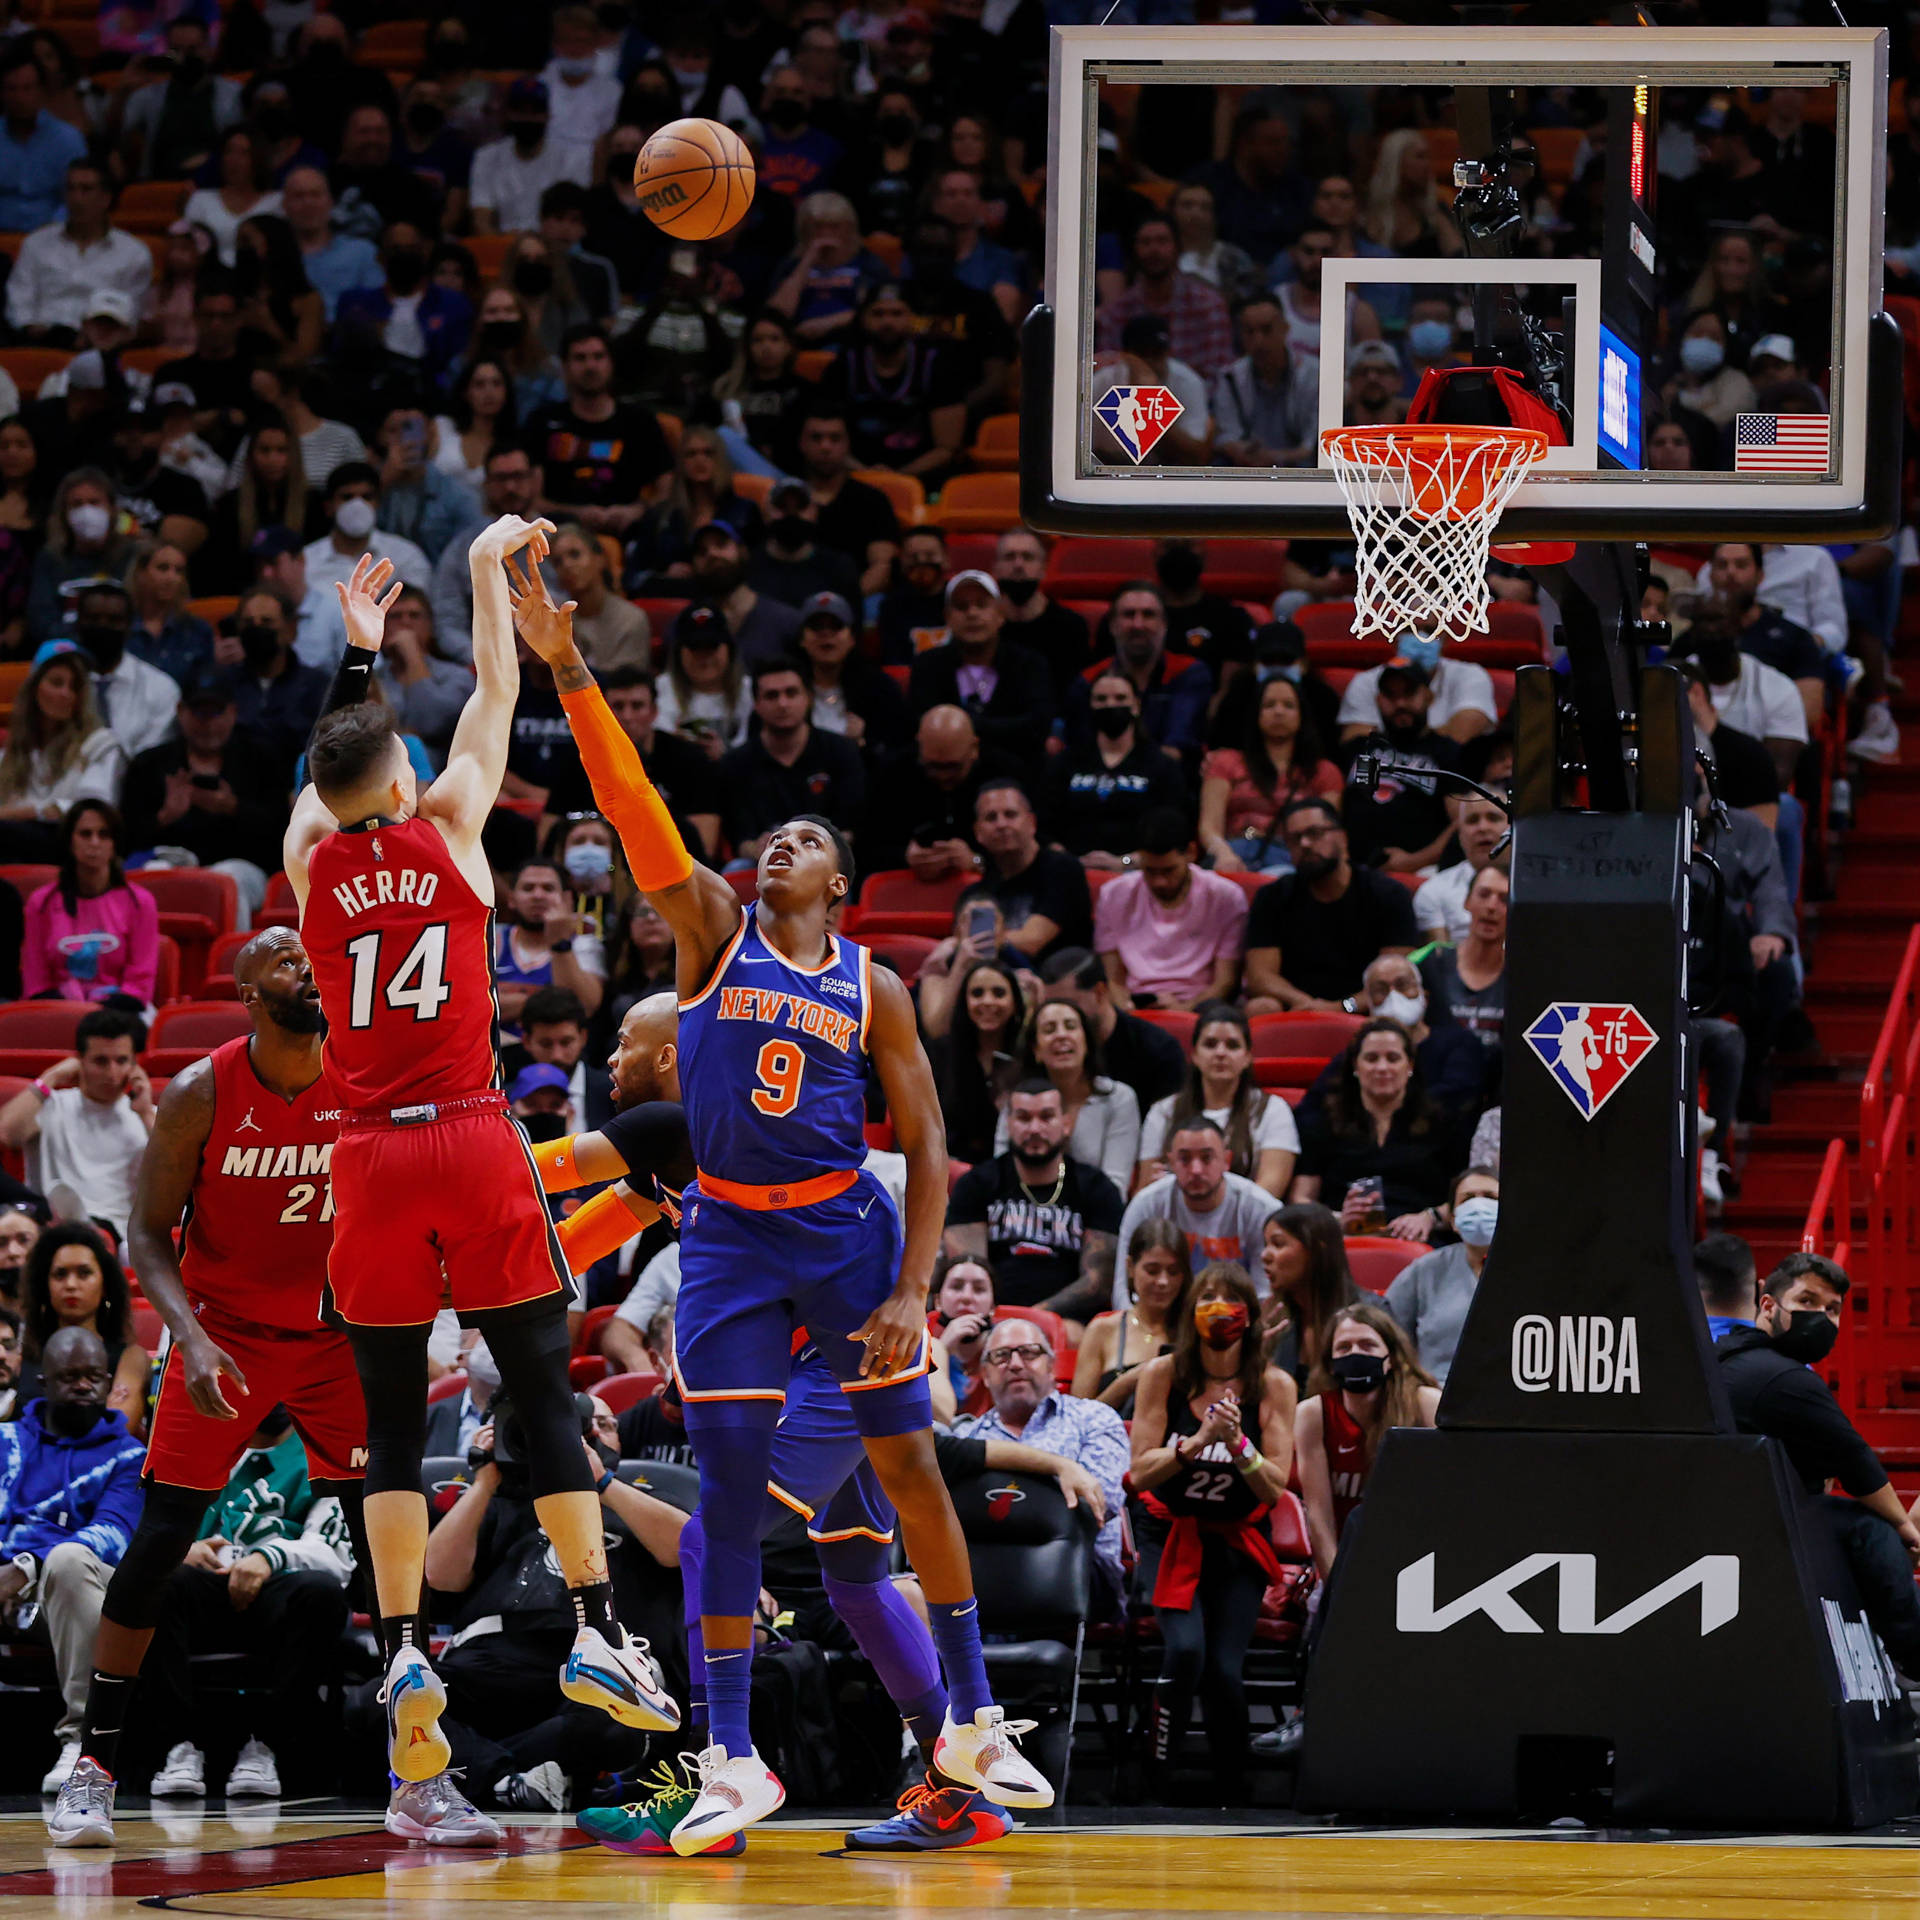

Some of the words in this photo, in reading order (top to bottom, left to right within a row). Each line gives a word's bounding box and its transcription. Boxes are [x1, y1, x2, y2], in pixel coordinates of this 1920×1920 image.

[1147, 397, 1164, 420] 75
[332, 868, 439, 919] HERRO
[346, 922, 452, 1030] 14
[819, 984, 849, 998] SPACE
[821, 976, 858, 993] SQUARE
[716, 986, 787, 1024] NEW
[785, 994, 860, 1054] YORK
[1603, 1021, 1628, 1054] 75
[750, 1038, 807, 1118] 9
[220, 1143, 335, 1178] MIAM
[279, 1183, 336, 1223] 21
[1511, 1313, 1641, 1394] @NBA
[1184, 1469, 1234, 1502] 22
[1396, 1551, 1741, 1637] KIA
